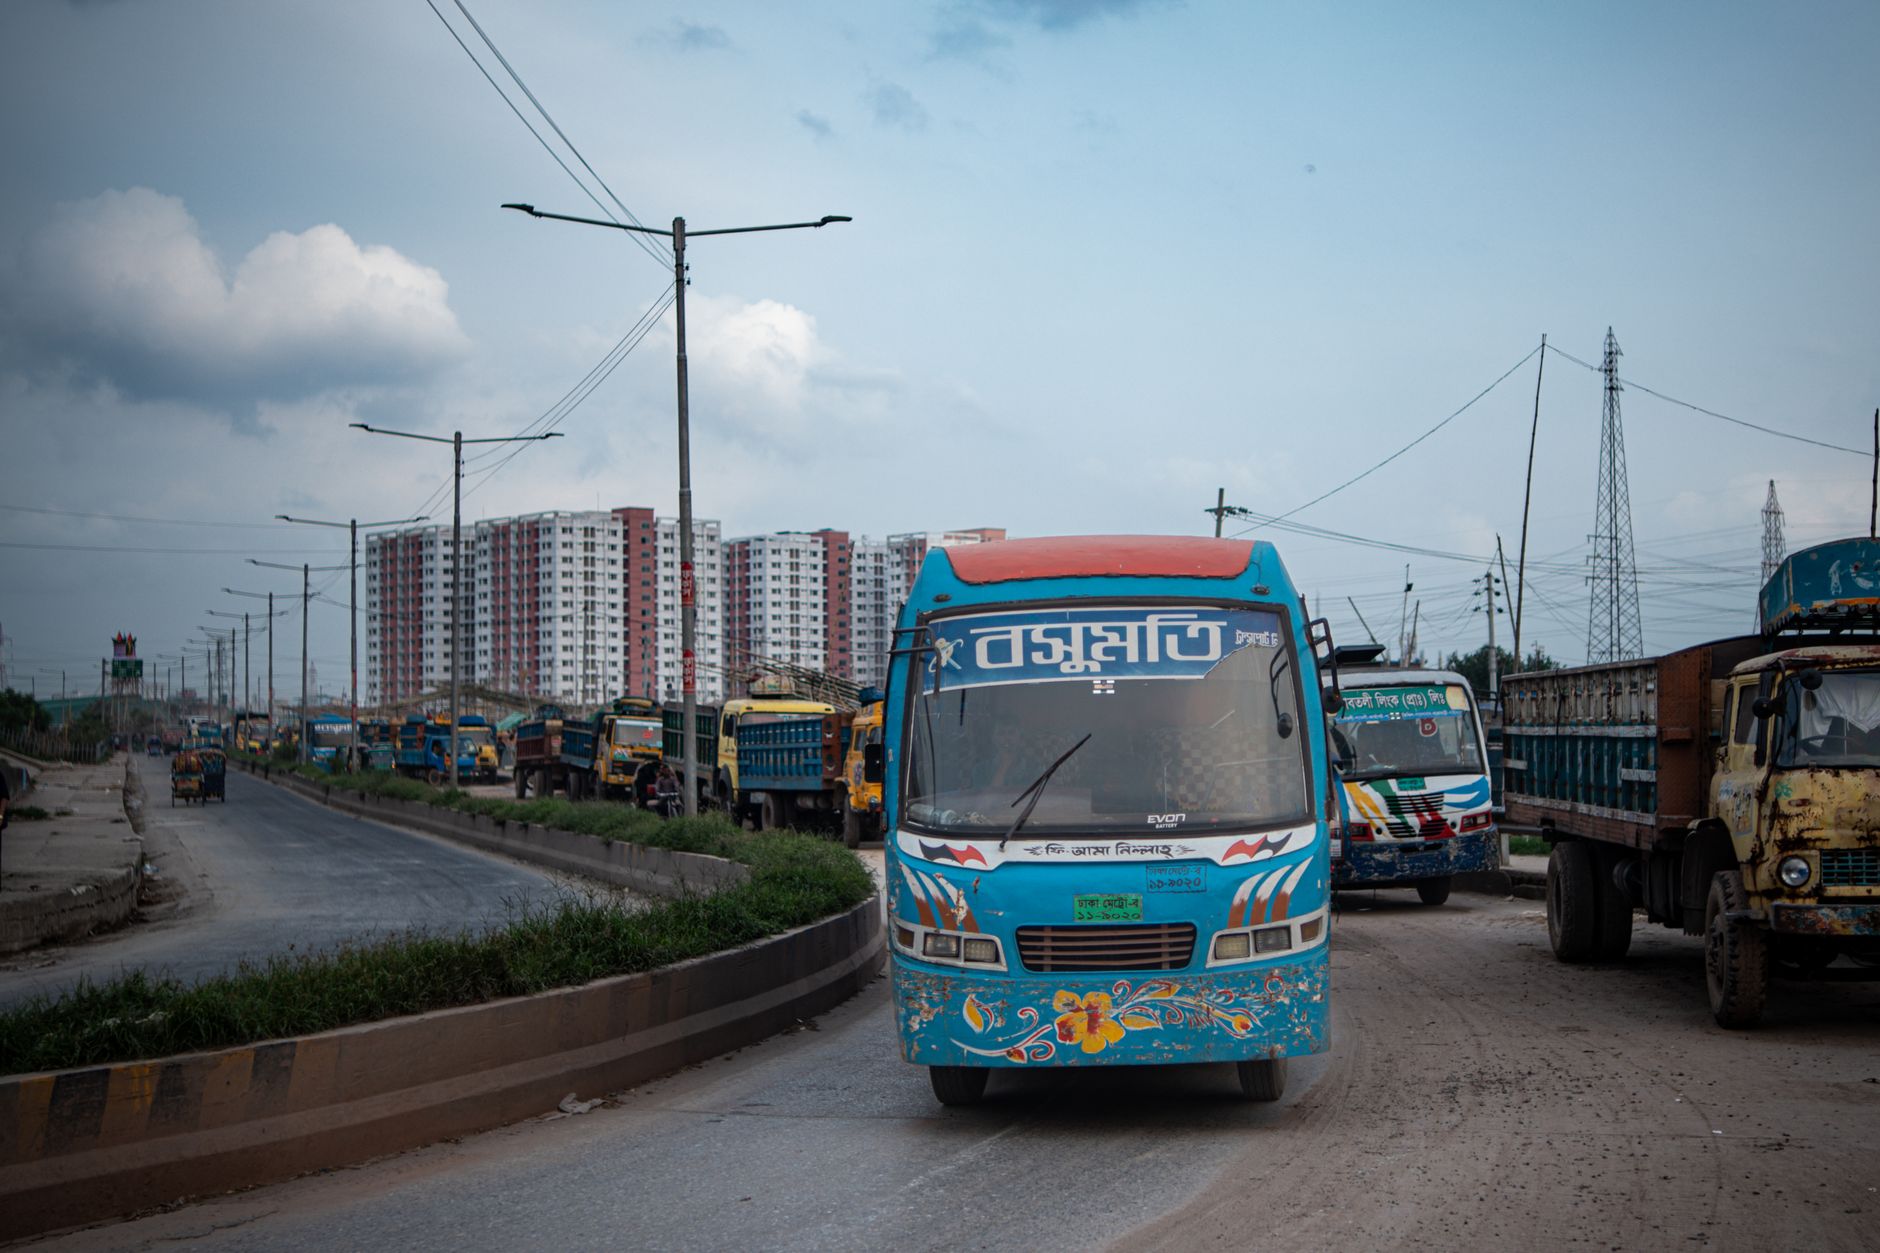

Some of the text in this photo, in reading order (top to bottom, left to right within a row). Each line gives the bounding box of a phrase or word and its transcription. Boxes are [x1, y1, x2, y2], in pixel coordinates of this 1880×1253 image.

[970, 614, 1227, 673] বসুমতি
[1343, 689, 1446, 710] াবতলী লিংক (প্রাঃ) লিঃ
[1147, 813, 1186, 824] EVON
[1078, 899, 1099, 909] ঢাকা
